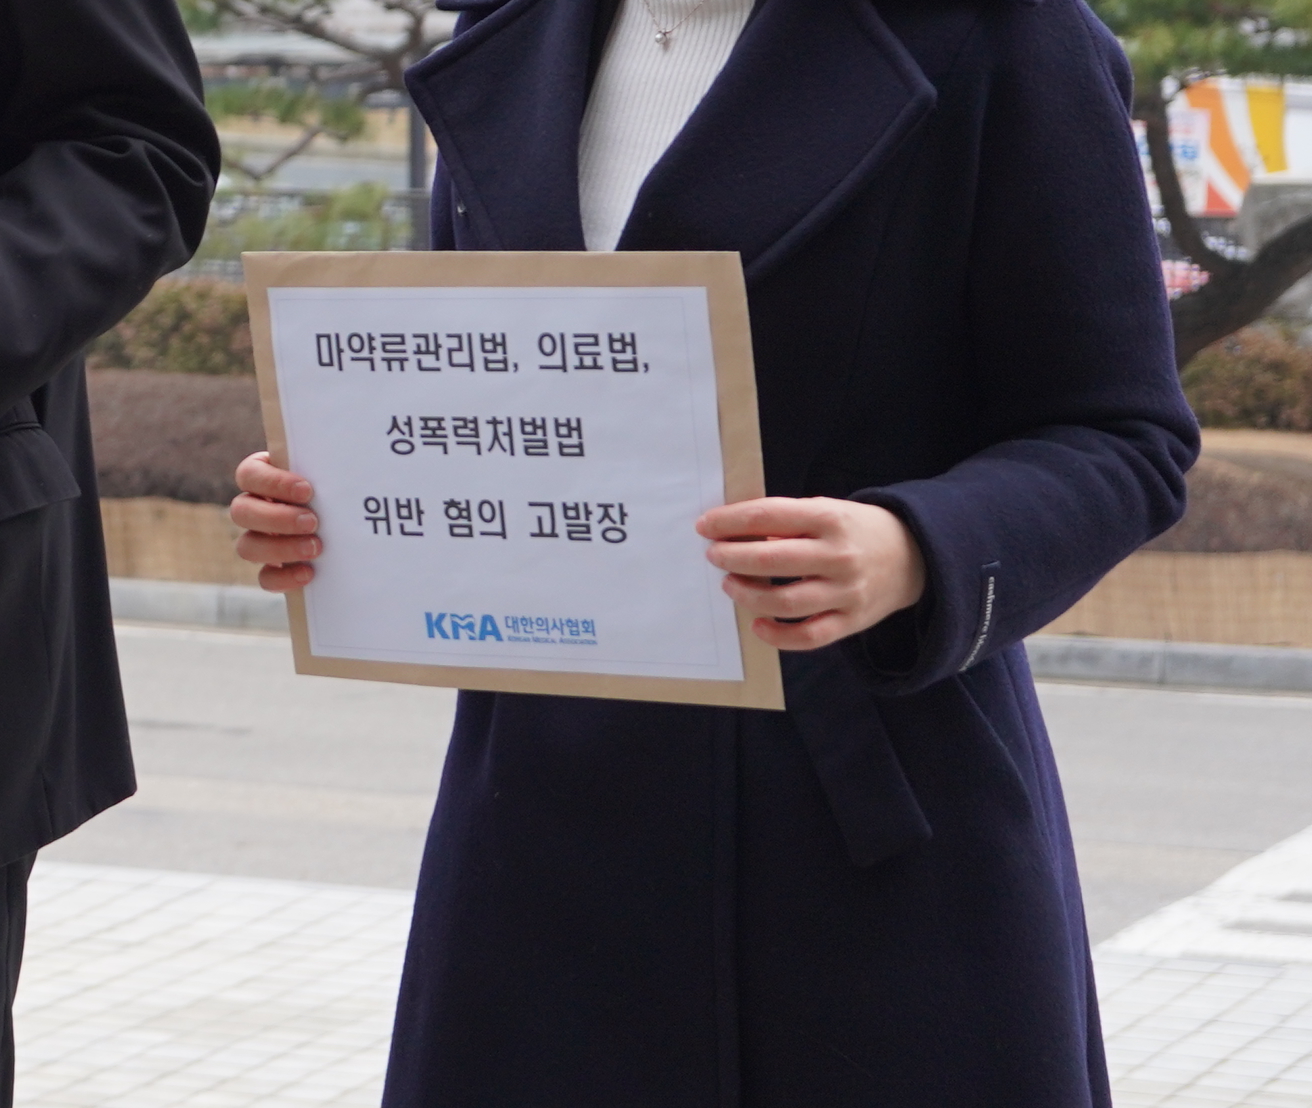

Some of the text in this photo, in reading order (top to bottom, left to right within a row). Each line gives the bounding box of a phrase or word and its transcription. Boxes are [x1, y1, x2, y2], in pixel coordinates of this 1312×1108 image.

[315, 332, 650, 373] 마약류관리법, 의료법,
[386, 415, 586, 457] 성폭력처벌법
[363, 496, 629, 544] 위반 혐의 고발장
[982, 576, 995, 633] cashmere
[425, 612, 504, 641] KMA
[504, 616, 596, 637] 대한의사협회
